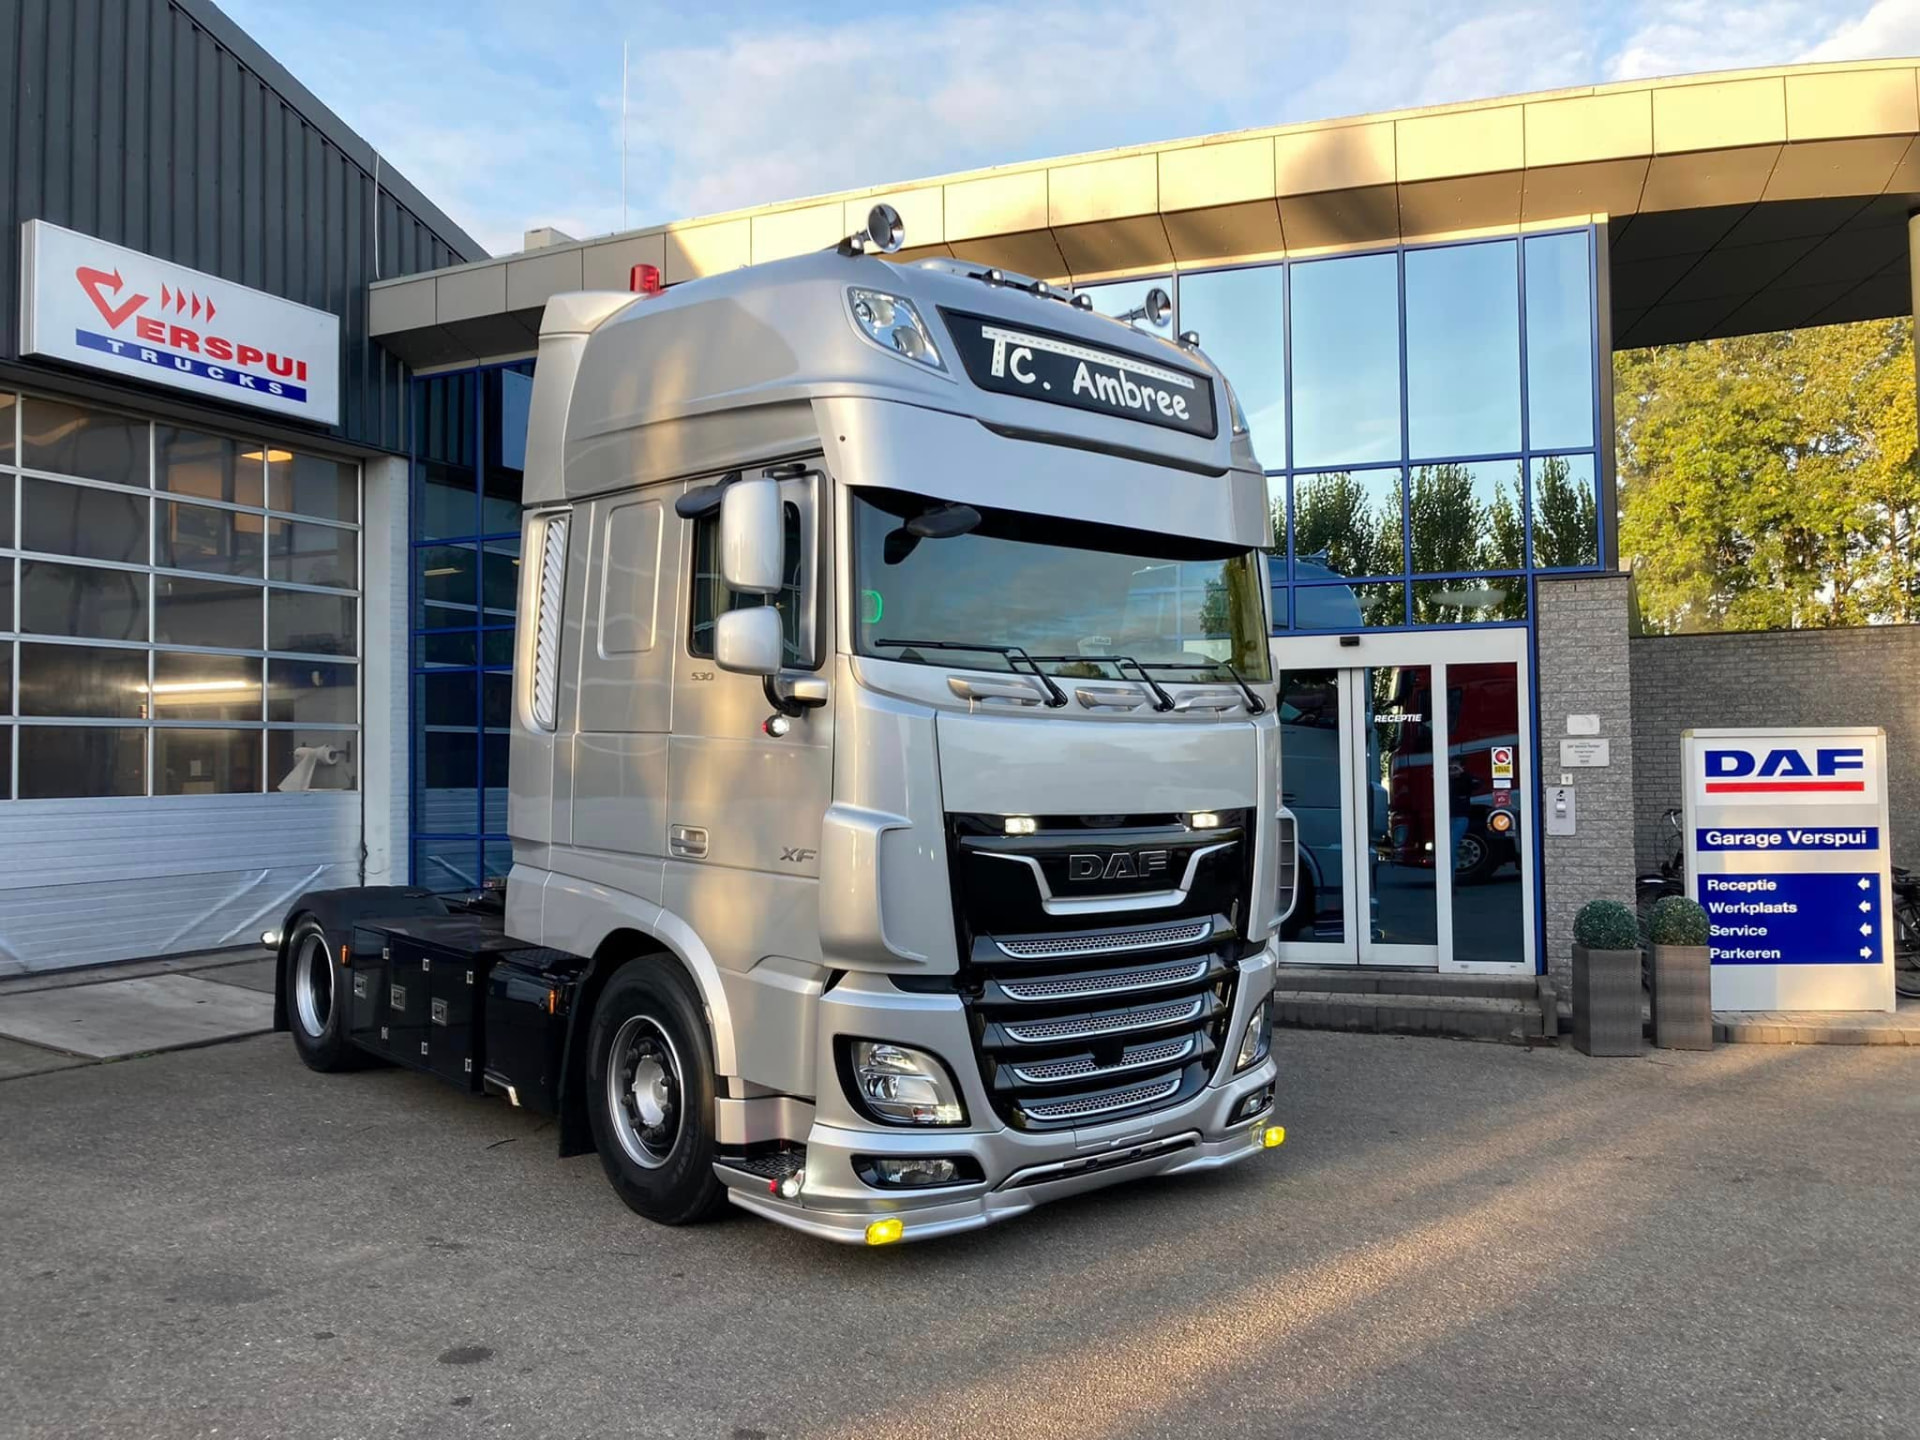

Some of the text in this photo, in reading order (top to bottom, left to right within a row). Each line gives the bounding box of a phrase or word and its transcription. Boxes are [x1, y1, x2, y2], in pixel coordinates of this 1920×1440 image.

[75, 266, 307, 381] VERSPUI
[107, 339, 283, 395] TRUCKS
[1072, 361, 1190, 421] Ambree
[691, 671, 714, 681] 530
[1374, 713, 1422, 723] RECEPTIE
[1704, 748, 1864, 778] DAF
[1705, 830, 1867, 848] Garage Verspui
[779, 847, 816, 862] XF
[1069, 850, 1167, 880] DAF
[1707, 879, 1777, 892] Receptie
[1708, 902, 1798, 915] Werkplaats
[1709, 925, 1768, 937] Service
[1709, 947, 1781, 959] Parkeren
